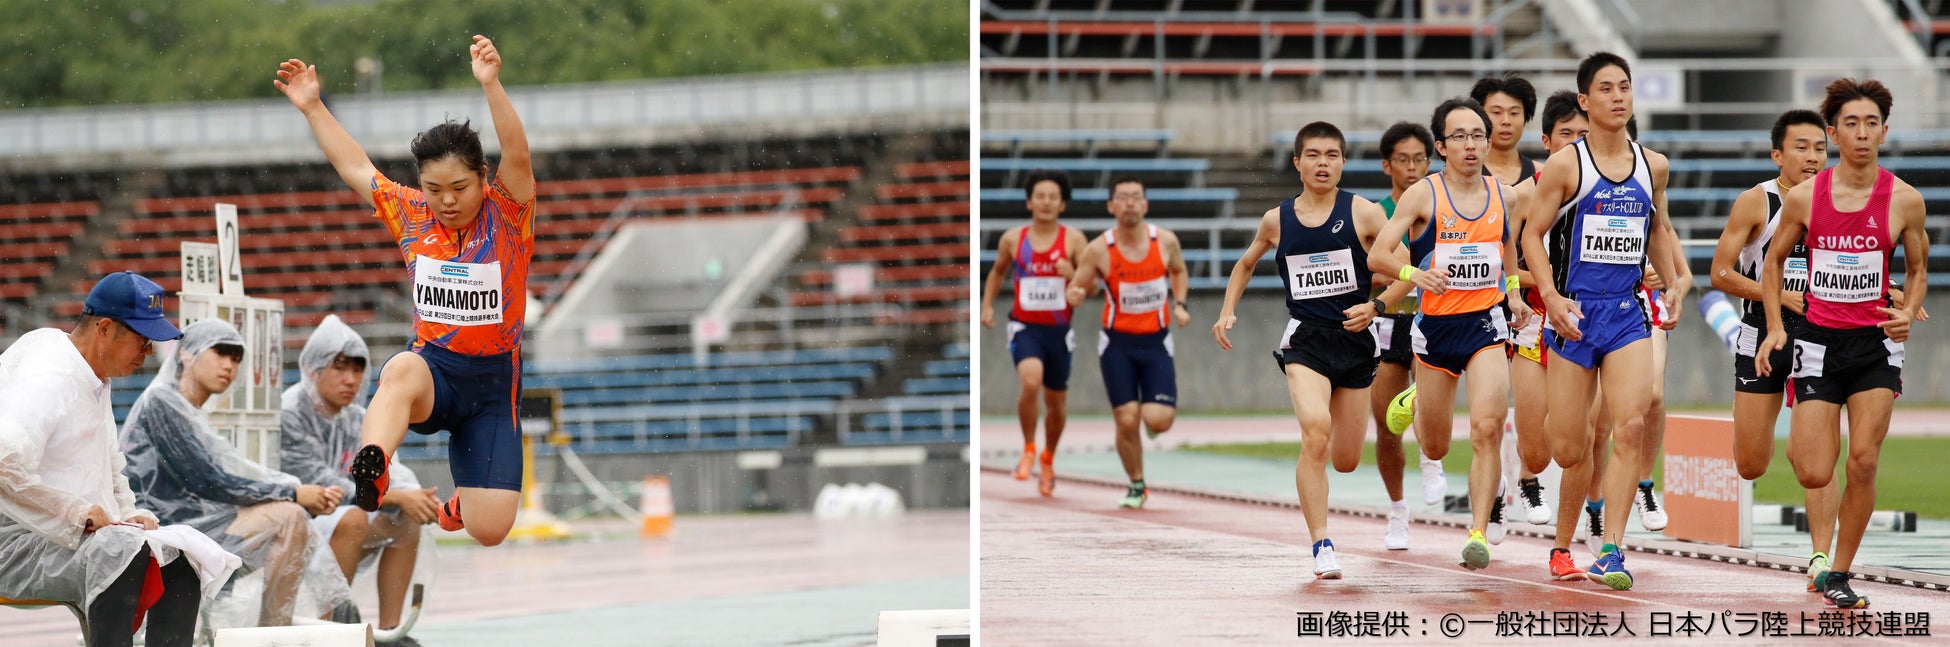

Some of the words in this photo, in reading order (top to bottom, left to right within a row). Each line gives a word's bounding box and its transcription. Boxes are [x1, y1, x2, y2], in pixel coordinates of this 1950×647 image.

[1440, 232, 1467, 240] 島本PJT
[1585, 235, 1642, 252] TAKECHI
[1817, 235, 1879, 250] SUMCO
[226, 221, 239, 281] 2
[441, 266, 469, 276] CENTRAL
[1296, 269, 1349, 288] TAGURI
[1448, 263, 1489, 279] SAITO
[1814, 271, 1879, 290] OKAWACHI
[417, 283, 499, 311] YAMAMOTO
